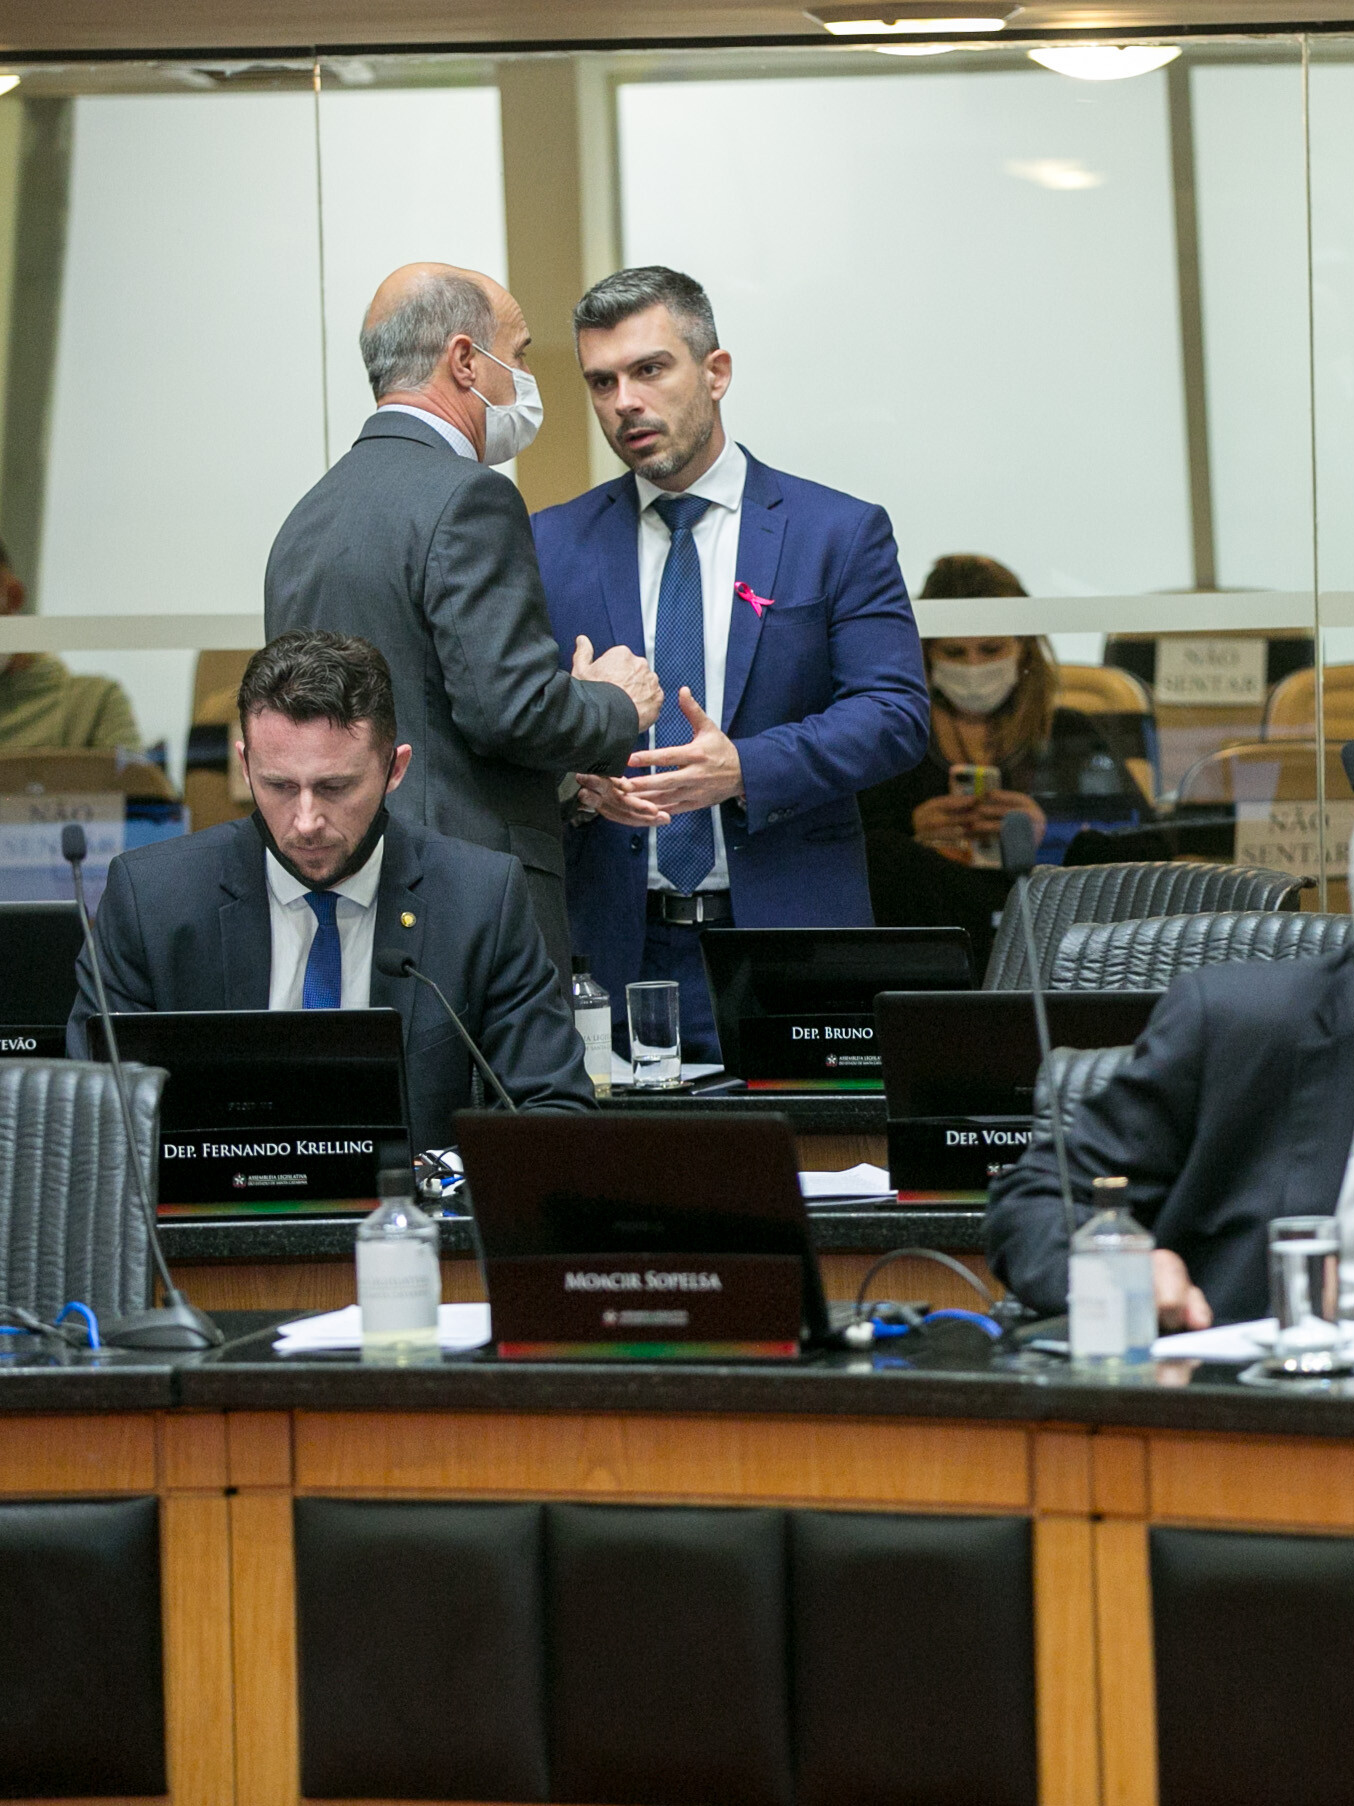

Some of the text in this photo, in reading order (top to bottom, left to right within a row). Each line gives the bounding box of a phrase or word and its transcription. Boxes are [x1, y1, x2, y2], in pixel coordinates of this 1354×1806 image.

[1269, 806, 1330, 833] NÃO
[792, 1026, 874, 1039] DEP. BRUNO
[0, 1037, 37, 1050] EVÃO
[946, 1130, 979, 1145] DEP.
[164, 1140, 373, 1159] DEP. FERNANDO KRELLING
